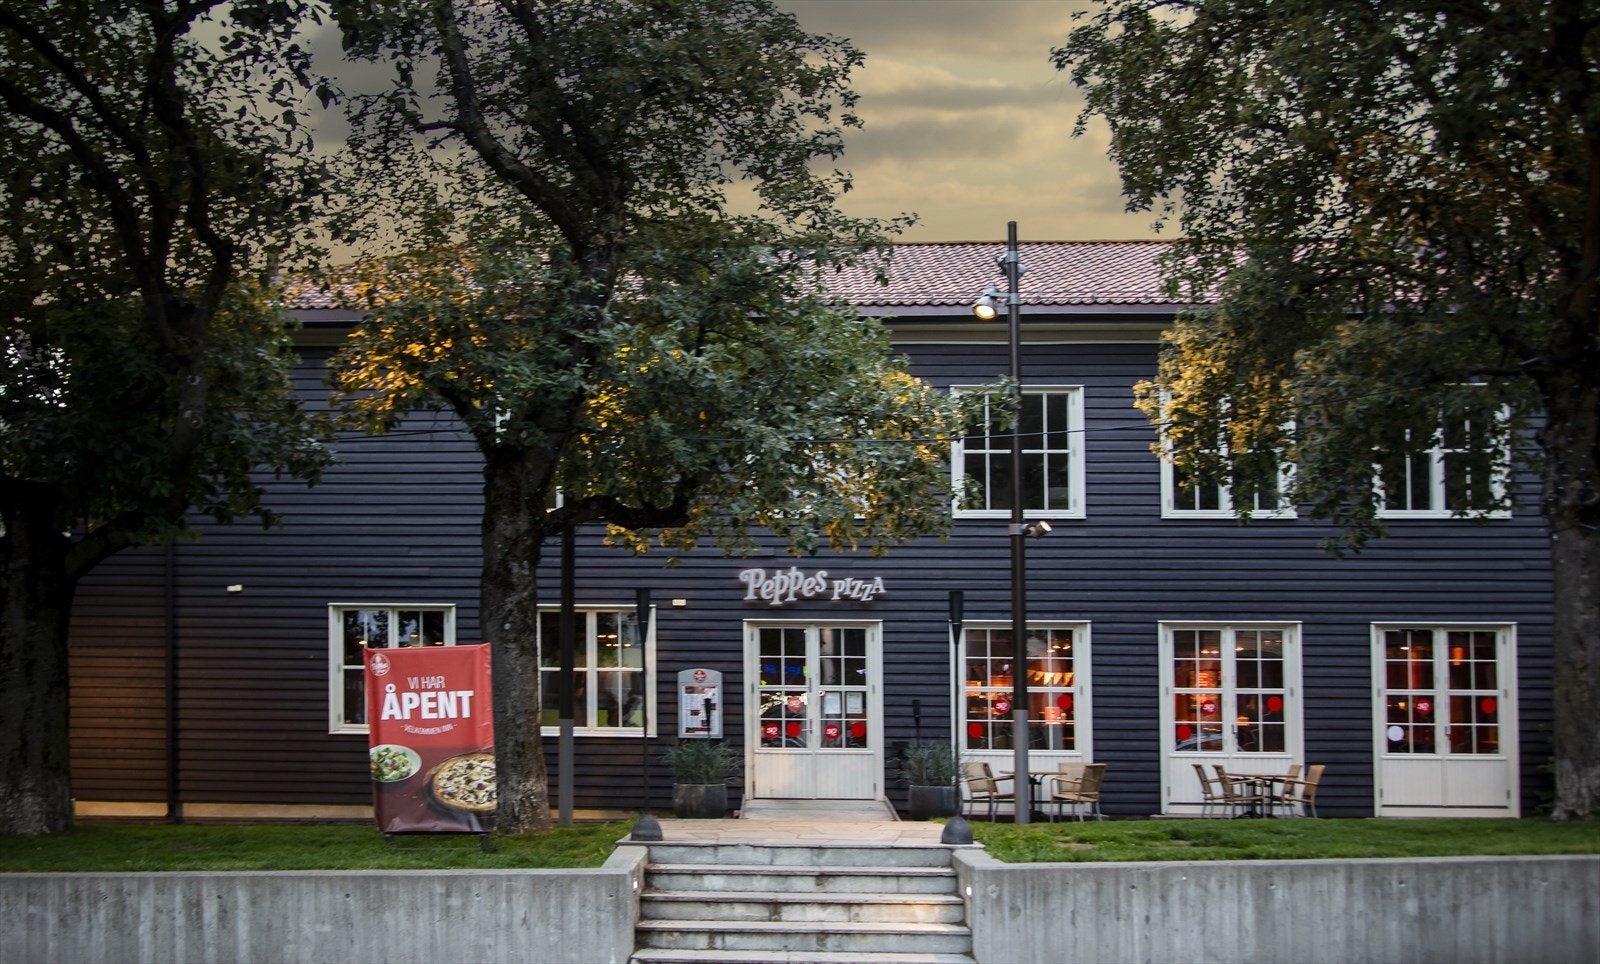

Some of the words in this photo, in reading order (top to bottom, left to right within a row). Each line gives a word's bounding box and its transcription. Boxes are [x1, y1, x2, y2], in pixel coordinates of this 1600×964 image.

[739, 566, 828, 605] Peppes
[831, 576, 888, 602] PIZZA
[407, 677, 419, 690] VI
[420, 675, 446, 689] HAR
[381, 683, 474, 721] ÅPENT
